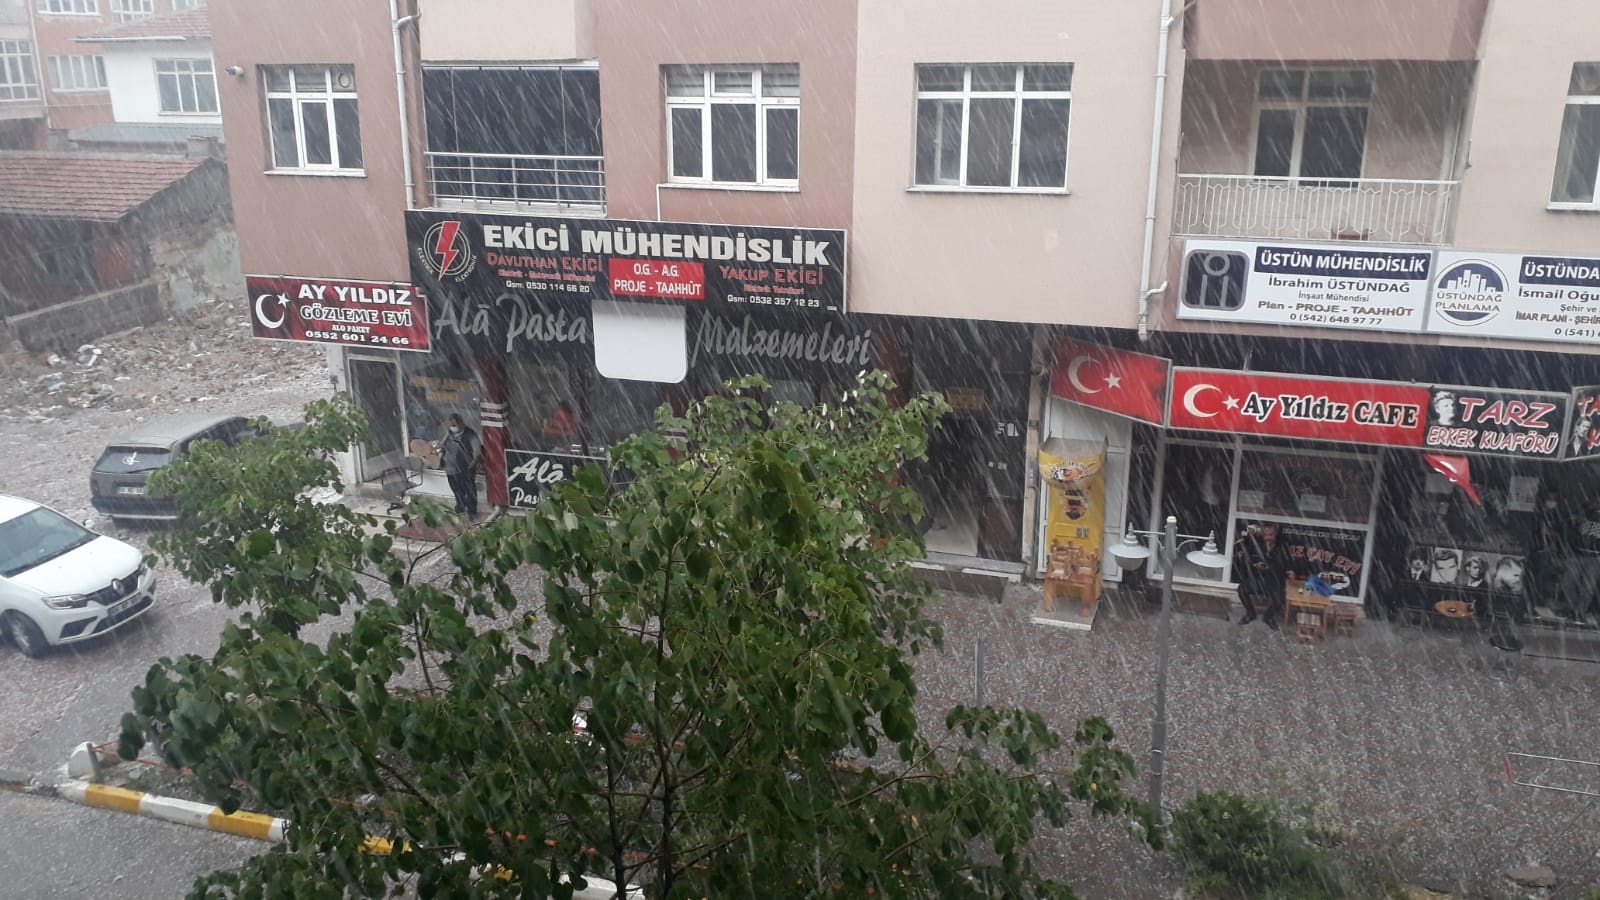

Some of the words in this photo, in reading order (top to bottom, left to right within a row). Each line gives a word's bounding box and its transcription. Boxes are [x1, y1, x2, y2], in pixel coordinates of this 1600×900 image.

[483, 222, 570, 252] EKİCİ
[581, 226, 830, 266] MÜHENDİSLİK
[487, 252, 557, 270] DAVUTHAN
[562, 254, 603, 272] EKİCİ
[1261, 250, 1313, 267] ÜSTÜN
[1316, 253, 1426, 273] MÜHENDİSLİK
[719, 265, 769, 281] YAKUP
[775, 265, 824, 284] EKİCİ
[526, 281, 547, 290] 0530
[549, 283, 565, 292] 114
[580, 285, 590, 293] 20
[614, 280, 646, 292] PROJE
[1268, 275, 1323, 289] İbrahim
[1327, 279, 1410, 293] ÜSTÜNDAĞ
[1518, 286, 1564, 299] İsmail
[298, 284, 326, 300] AY
[334, 286, 412, 306] YILDIZ
[727, 294, 747, 303] Gsm:
[749, 295, 772, 305] 0532
[774, 297, 791, 306] 357
[794, 298, 806, 307] 12
[807, 299, 819, 308] 23
[301, 303, 379, 324] GÖZLEME
[382, 308, 412, 326] EVİ
[1258, 301, 1285, 310] Plan
[1296, 303, 1339, 313] PROJE
[1435, 301, 1500, 312] PLANLAMA
[1560, 304, 1584, 313] Şehir
[496, 293, 586, 352] Pasta
[1300, 314, 1326, 323] (542)
[1330, 315, 1350, 324] 648
[1353, 316, 1366, 325] 97
[1368, 317, 1382, 326] 77
[1516, 311, 1538, 321] İMAR
[1541, 313, 1567, 323] PLANI
[305, 330, 338, 339] 0552
[342, 333, 366, 342] 601
[371, 335, 388, 344] 24
[392, 337, 409, 345] 66
[1565, 328, 1595, 338] (541)
[1241, 391, 1277, 422] Ay
[1279, 394, 1349, 423] Yıldız
[1353, 399, 1420, 428] CAFE
[1459, 397, 1556, 429] TARZ
[1426, 426, 1479, 448] ERKEK
[1479, 430, 1560, 454] KUAFÖRÜ
[510, 487, 539, 506] Pas
